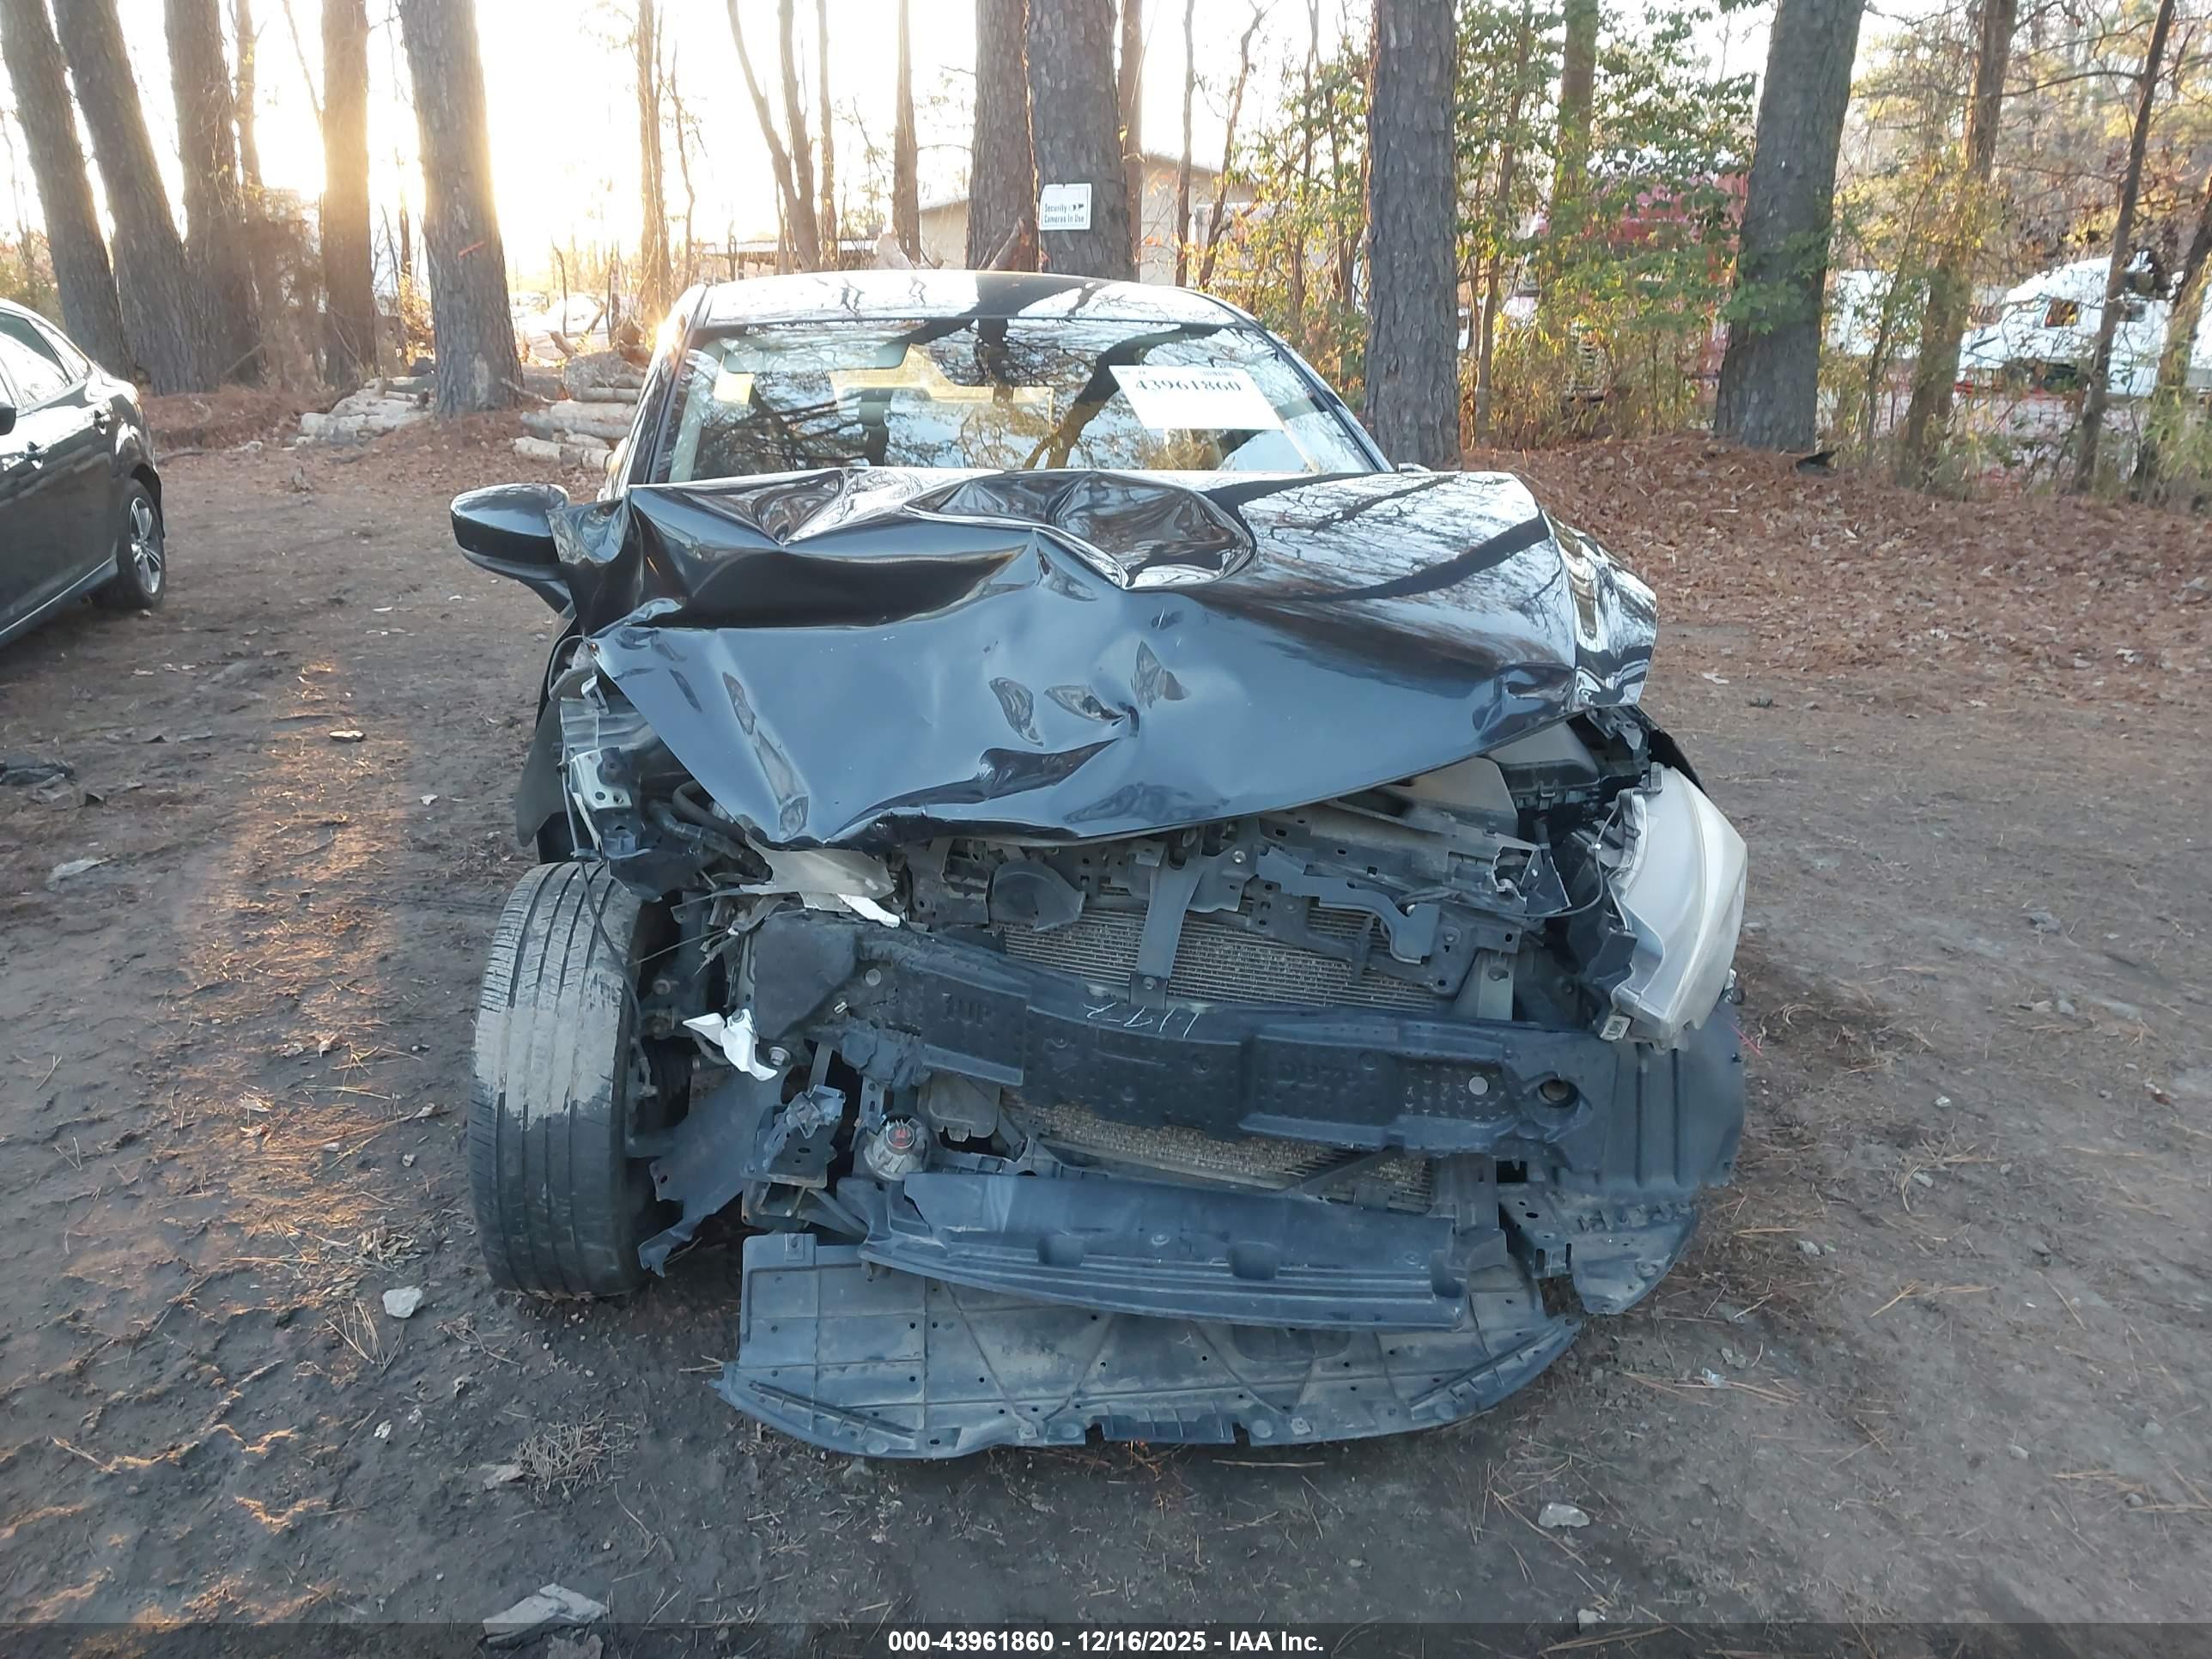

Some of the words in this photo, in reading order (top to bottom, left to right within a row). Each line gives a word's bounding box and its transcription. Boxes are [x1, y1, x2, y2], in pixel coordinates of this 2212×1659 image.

[1044, 203, 1066, 213] Security
[1044, 214, 1066, 223] Cameras
[1067, 214, 1073, 222] In
[1075, 214, 1085, 222] Use
[1135, 379, 1242, 392] 43961860
